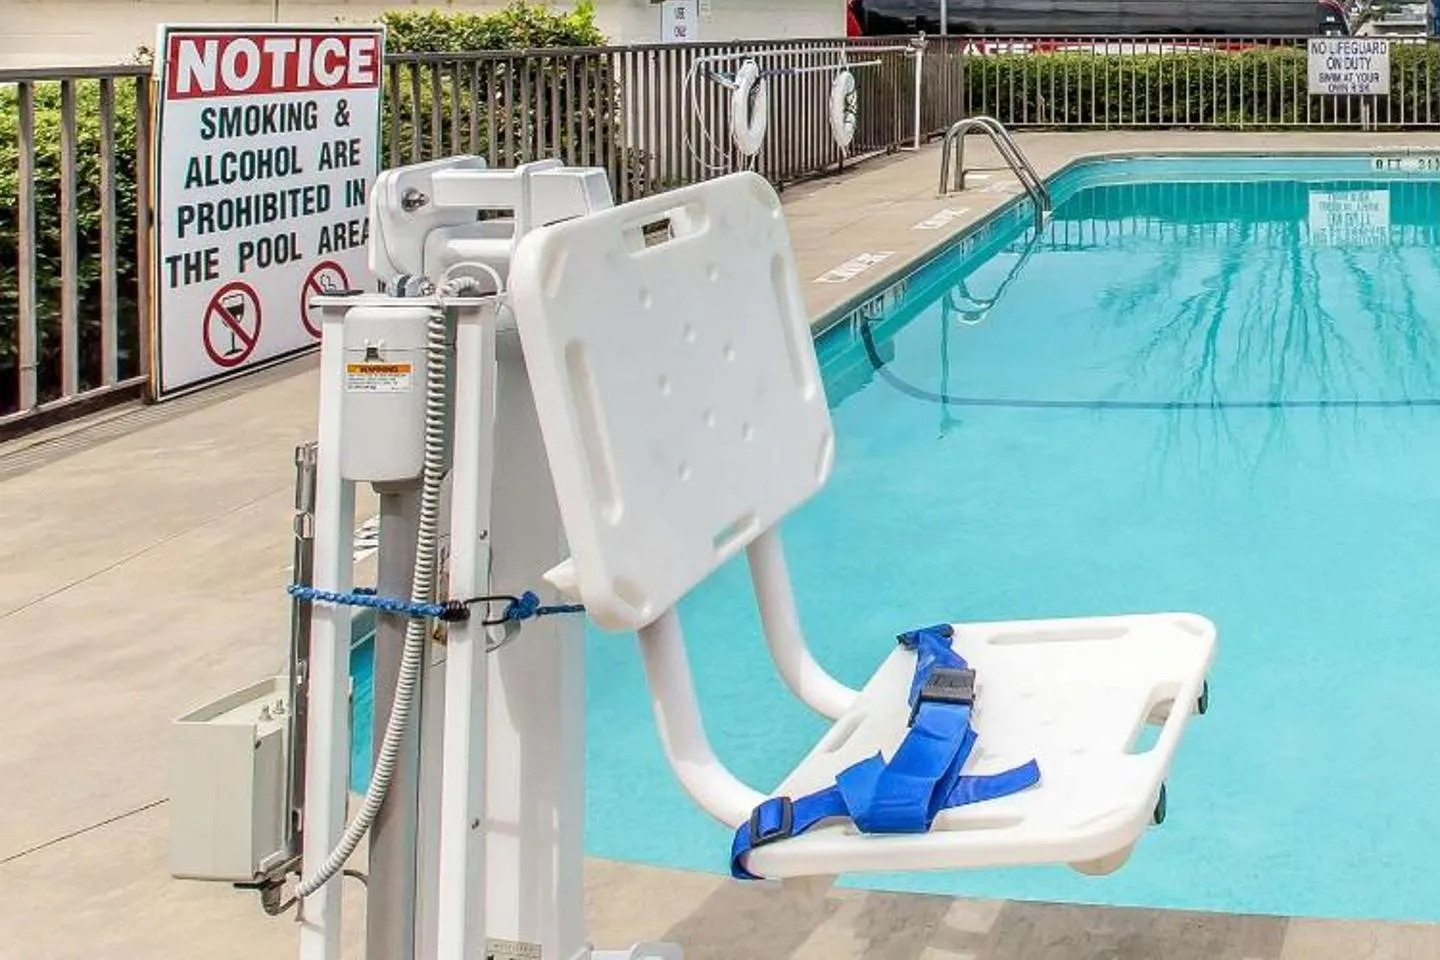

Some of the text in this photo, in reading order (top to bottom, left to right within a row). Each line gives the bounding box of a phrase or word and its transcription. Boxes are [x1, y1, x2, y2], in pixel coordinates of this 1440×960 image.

[175, 37, 375, 93] NOTICE
[1311, 41, 1387, 55] NO LIFEGUARD
[1326, 56, 1371, 70] ON DUTY
[1319, 72, 1379, 83] SWIM AT YOUR
[200, 98, 350, 140] SMOKING &
[183, 137, 361, 189] ALCOHOL ARE
[177, 177, 366, 239] PROHIBITED IN
[165, 246, 220, 289] THE
[238, 232, 303, 274] POOL
